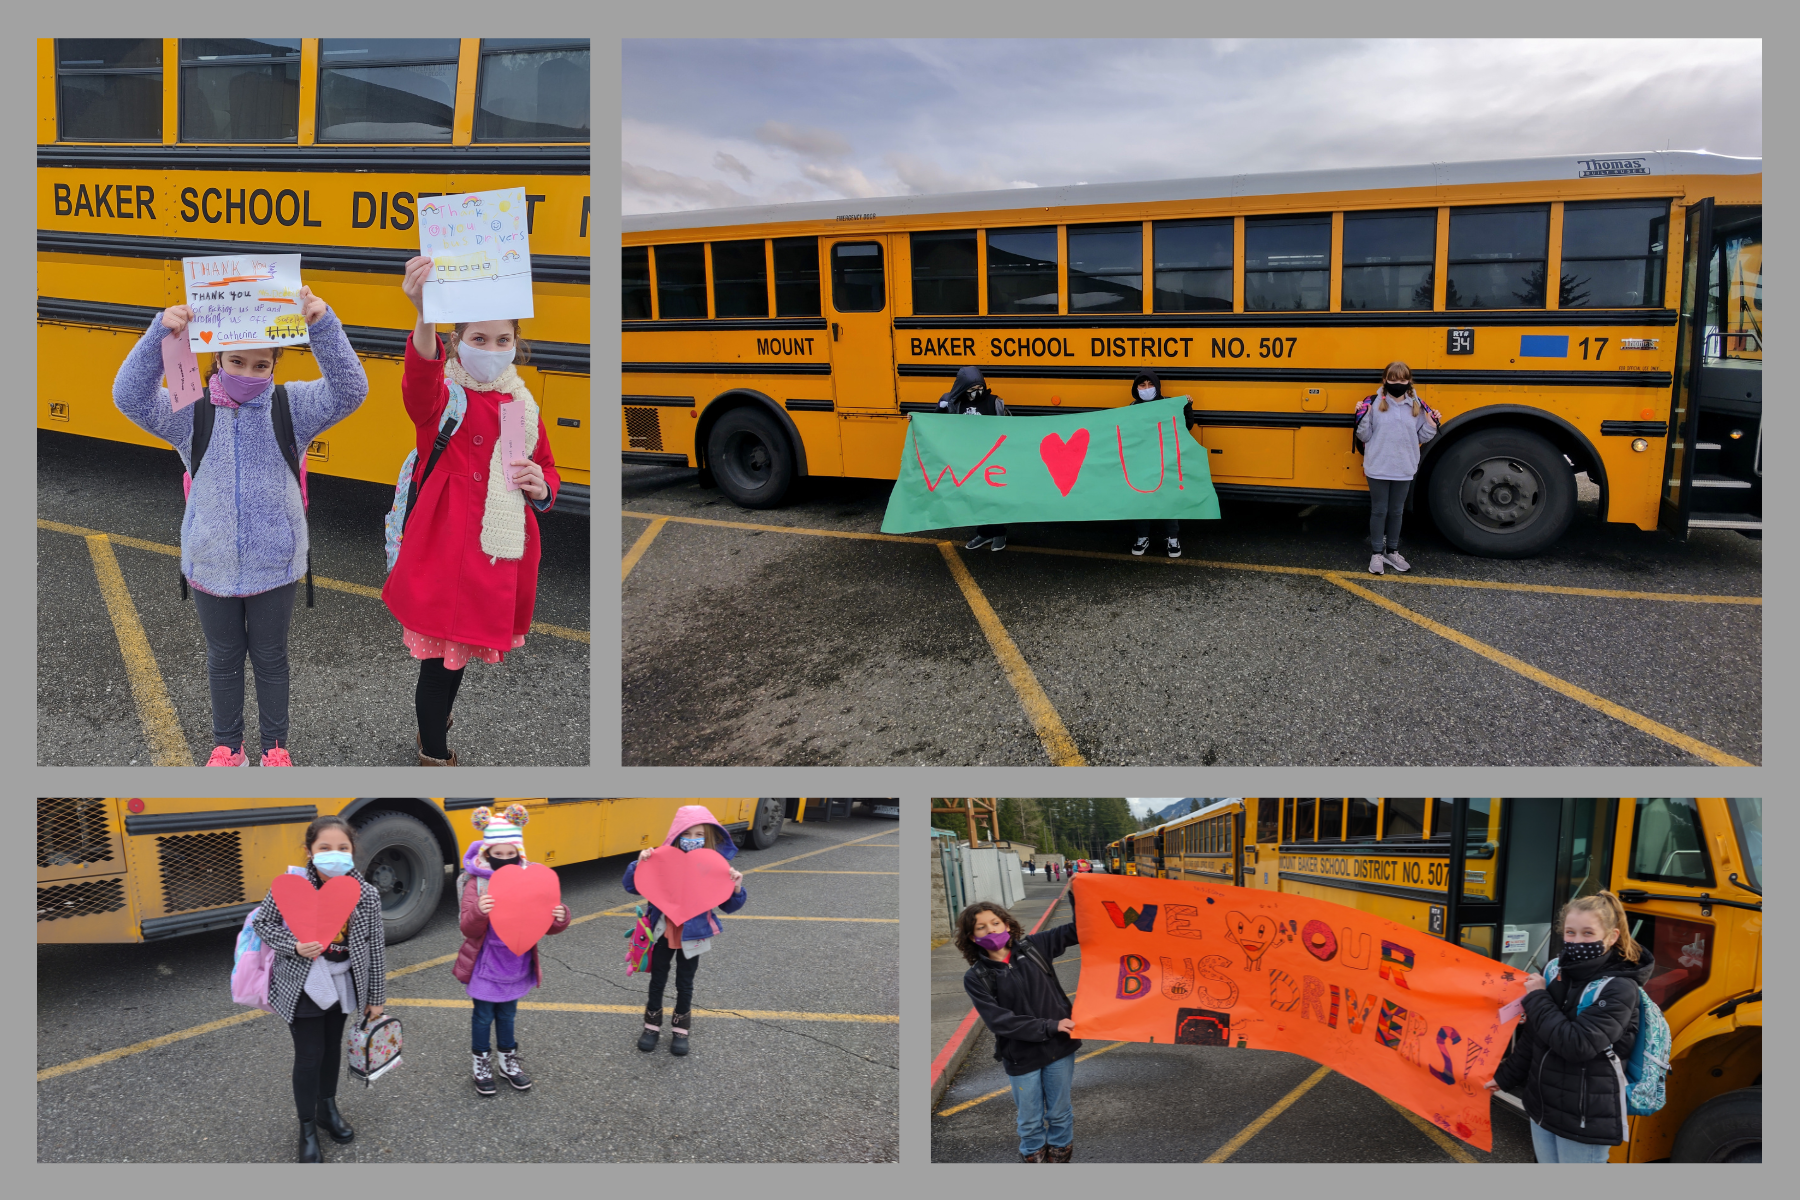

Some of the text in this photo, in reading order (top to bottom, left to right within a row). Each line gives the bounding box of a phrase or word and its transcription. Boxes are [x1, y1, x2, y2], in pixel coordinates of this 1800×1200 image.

[1577, 158, 1646, 170] Thomas
[53, 183, 156, 220] BAKER
[180, 187, 322, 227] SCHOOL
[352, 191, 545, 234] DIST
[187, 261, 241, 279] THANK
[192, 291, 225, 301] THANK
[757, 337, 1298, 359] MOUNT BAKER SCHOOL DISTRICT NO. 507
[1452, 337, 1470, 351] 34
[1579, 336, 1609, 360] 17
[911, 415, 1184, 494] We U!
[1298, 856, 1319, 873] BAKER
[1320, 858, 1351, 877] SCHOOL
[1354, 859, 1398, 881] DISTRICT
[1402, 861, 1424, 884] NO.
[1427, 862, 1450, 887] 507
[1101, 900, 1416, 990] WE OUR
[1115, 953, 1240, 1010] BUS
